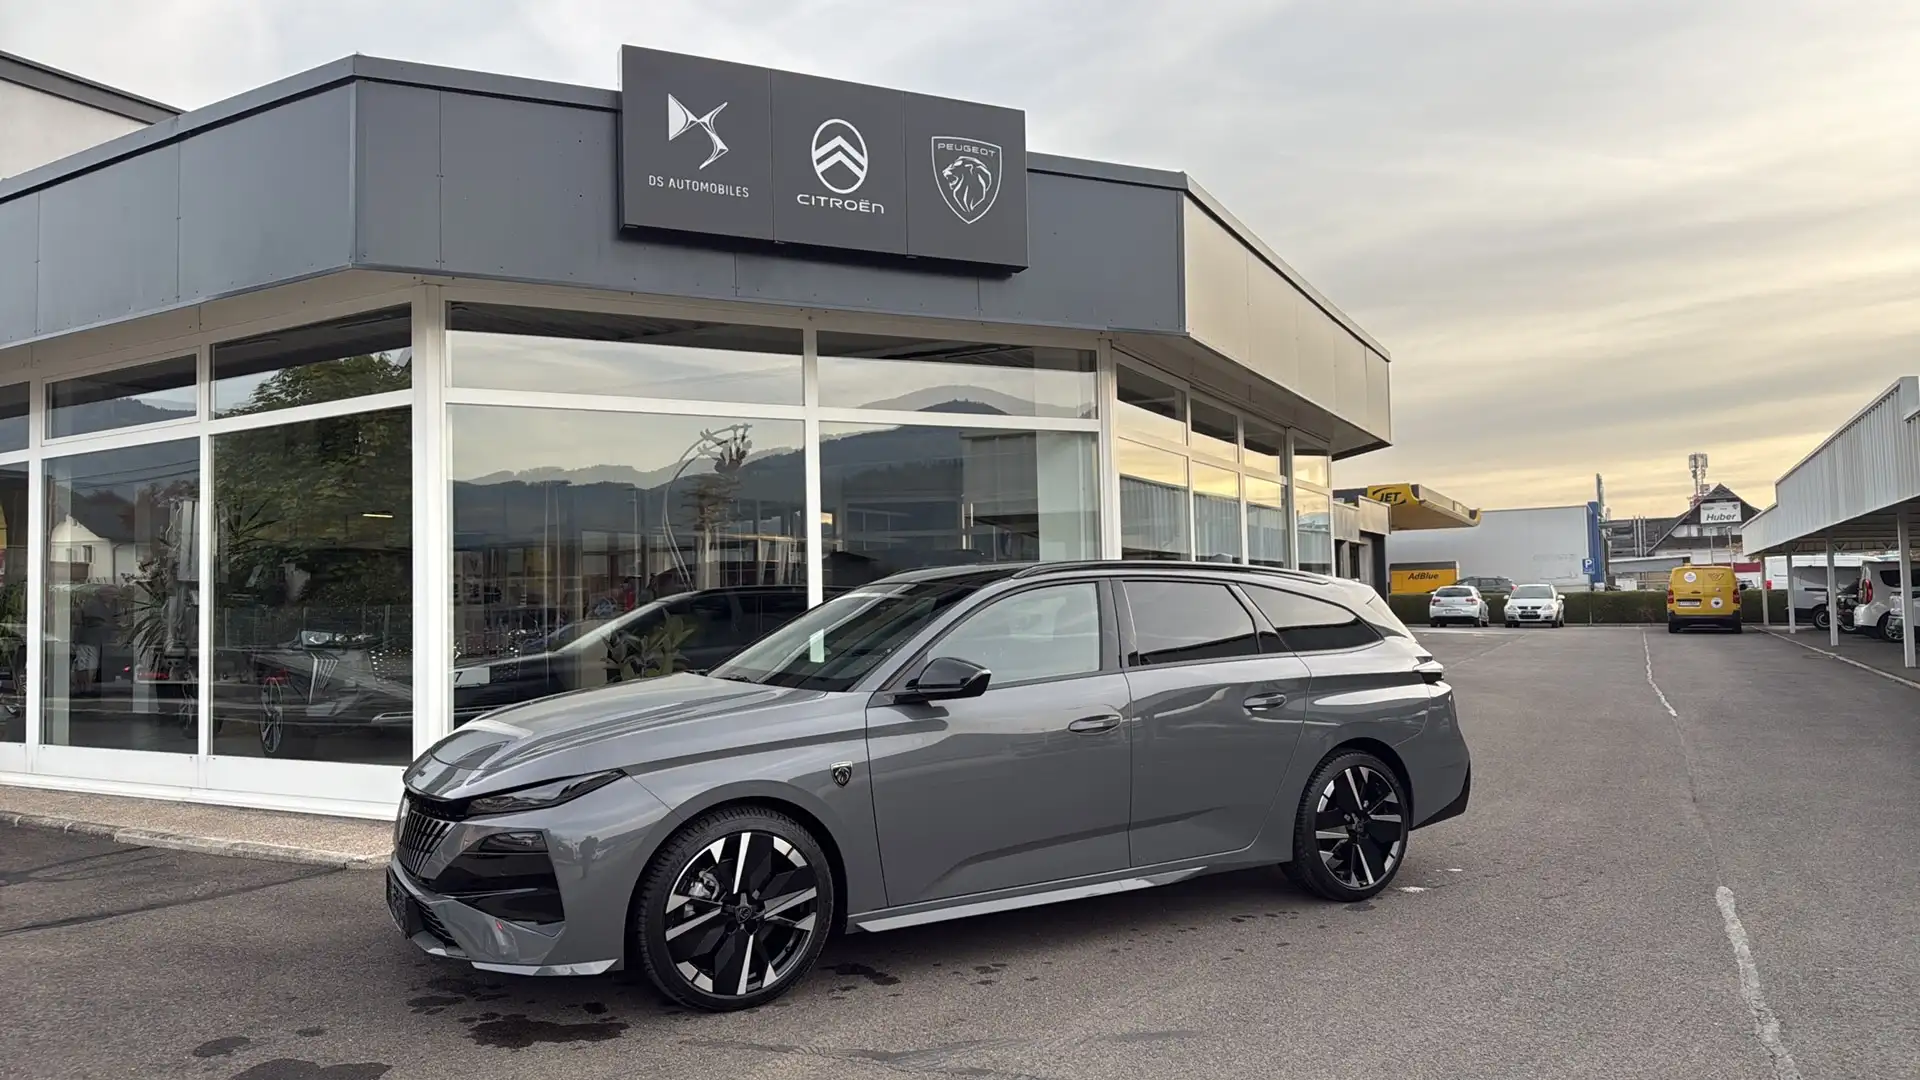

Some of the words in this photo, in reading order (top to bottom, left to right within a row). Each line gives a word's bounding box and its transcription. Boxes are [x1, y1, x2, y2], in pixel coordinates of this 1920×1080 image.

[937, 142, 997, 157] PEUGEOT
[648, 174, 664, 187] DS
[668, 177, 749, 198] AUTOMOBILES
[1380, 491, 1402, 502] JET
[1706, 513, 1737, 521] Huber
[1585, 559, 1593, 569] P
[1408, 571, 1440, 580] AdBlue
